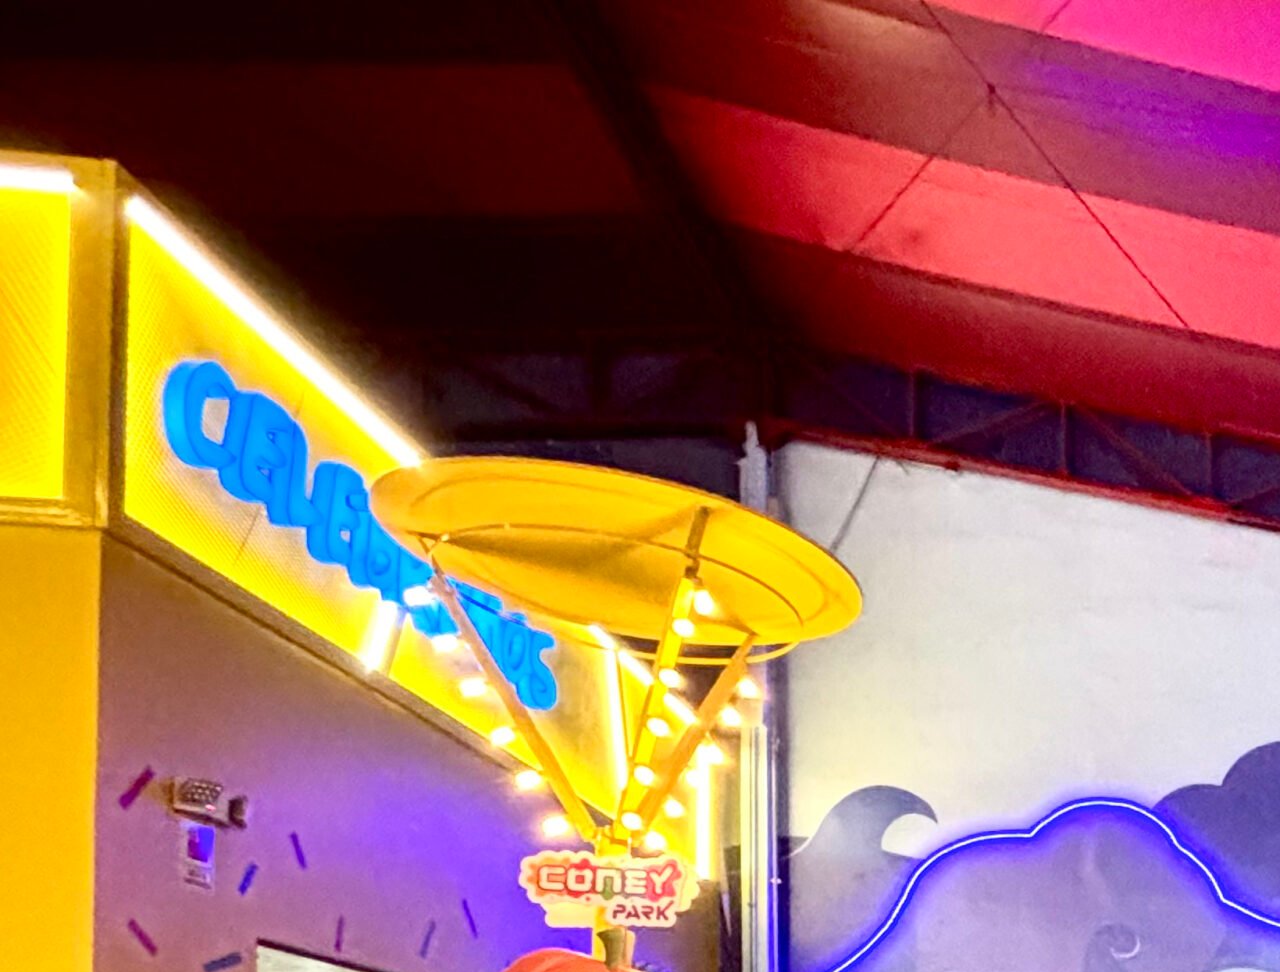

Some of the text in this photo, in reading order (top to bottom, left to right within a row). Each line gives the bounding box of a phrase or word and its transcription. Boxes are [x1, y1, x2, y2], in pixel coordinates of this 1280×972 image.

[162, 361, 557, 710] CELEBRMOS
[539, 863, 674, 895] CONEY
[612, 901, 673, 921] PARK
